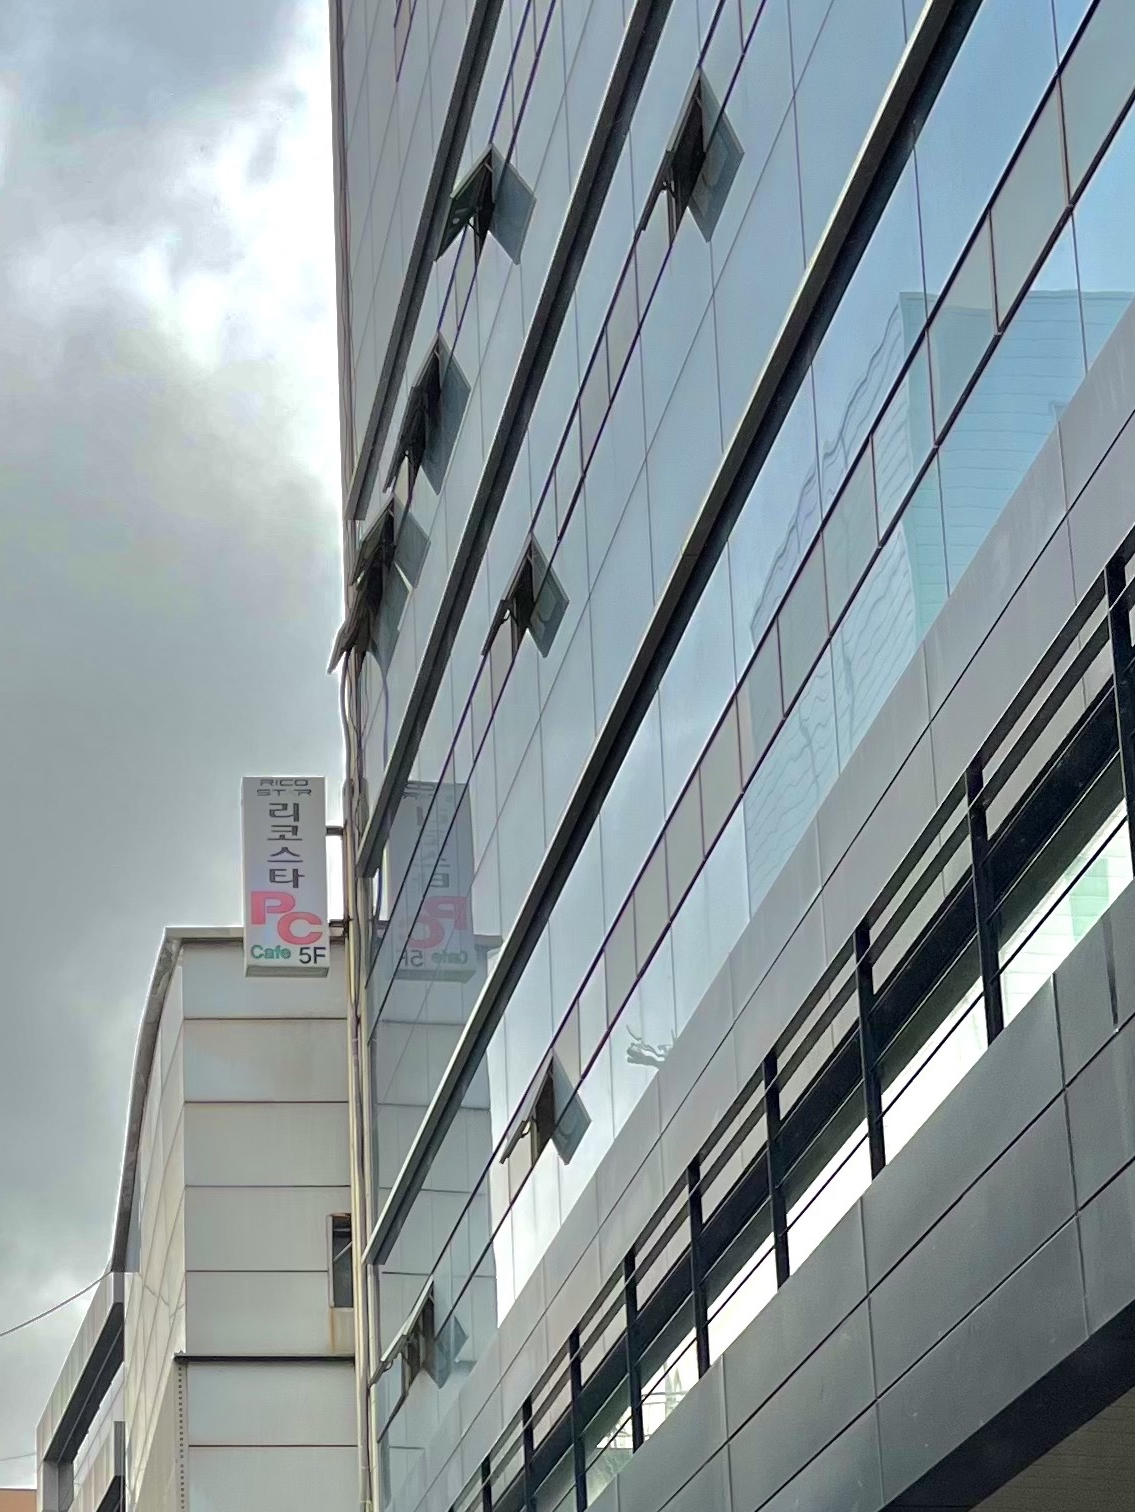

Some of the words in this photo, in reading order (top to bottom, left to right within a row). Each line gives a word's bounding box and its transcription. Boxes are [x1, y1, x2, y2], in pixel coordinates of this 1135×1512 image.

[260, 779, 309, 787] RICO
[267, 802, 305, 888] 리코스타
[250, 891, 323, 945] PC
[250, 944, 291, 960] Cafe
[299, 946, 326, 964] 5F
